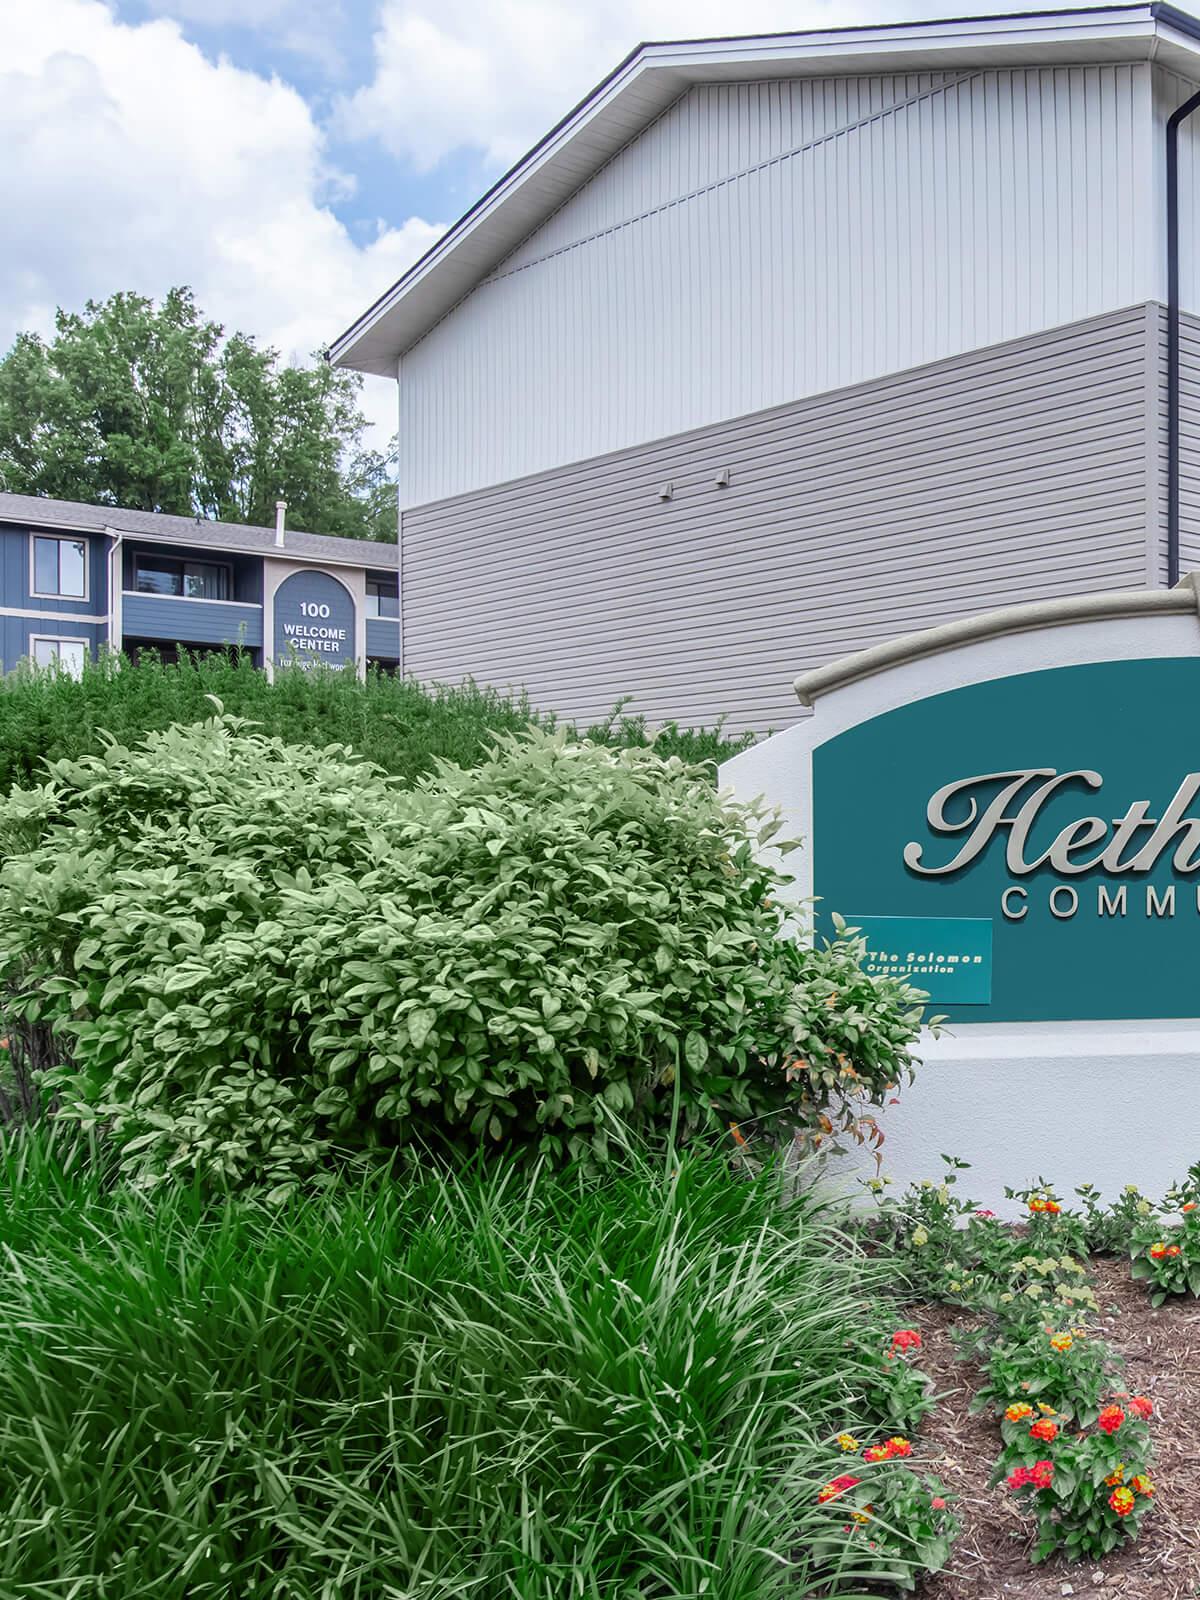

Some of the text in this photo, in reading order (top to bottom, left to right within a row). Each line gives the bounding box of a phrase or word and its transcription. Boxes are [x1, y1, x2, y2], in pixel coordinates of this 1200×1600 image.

[300, 602, 330, 618] 100
[284, 624, 346, 640] WELCOME
[290, 638, 339, 652] CENTER
[869, 952, 982, 963] The Solomon
[867, 964, 954, 974] Organization
